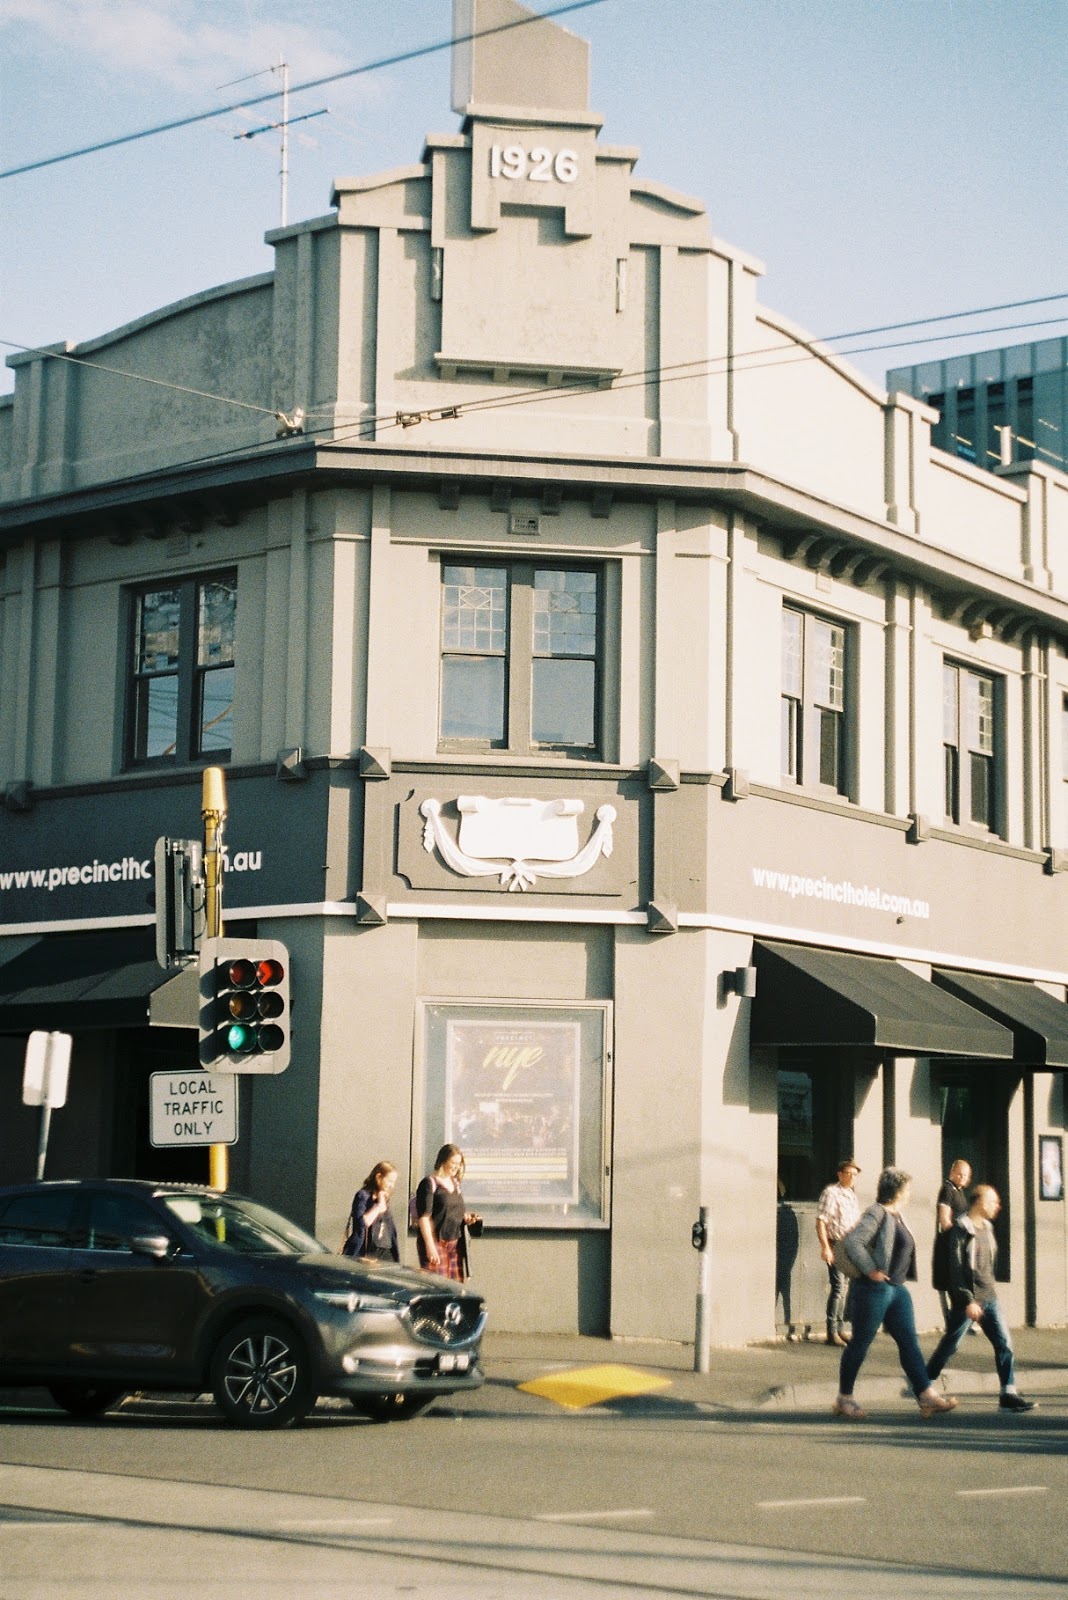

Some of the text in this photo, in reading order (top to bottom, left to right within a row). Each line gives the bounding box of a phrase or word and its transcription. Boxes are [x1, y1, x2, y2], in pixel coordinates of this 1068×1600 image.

[488, 144, 578, 182] 1926
[752, 867, 930, 919] www.precincthotel.com.au
[482, 1046, 546, 1092] nye
[169, 1080, 216, 1095] LOCAL
[164, 1100, 223, 1116] TRAFFIC
[174, 1121, 213, 1136] ONLY
